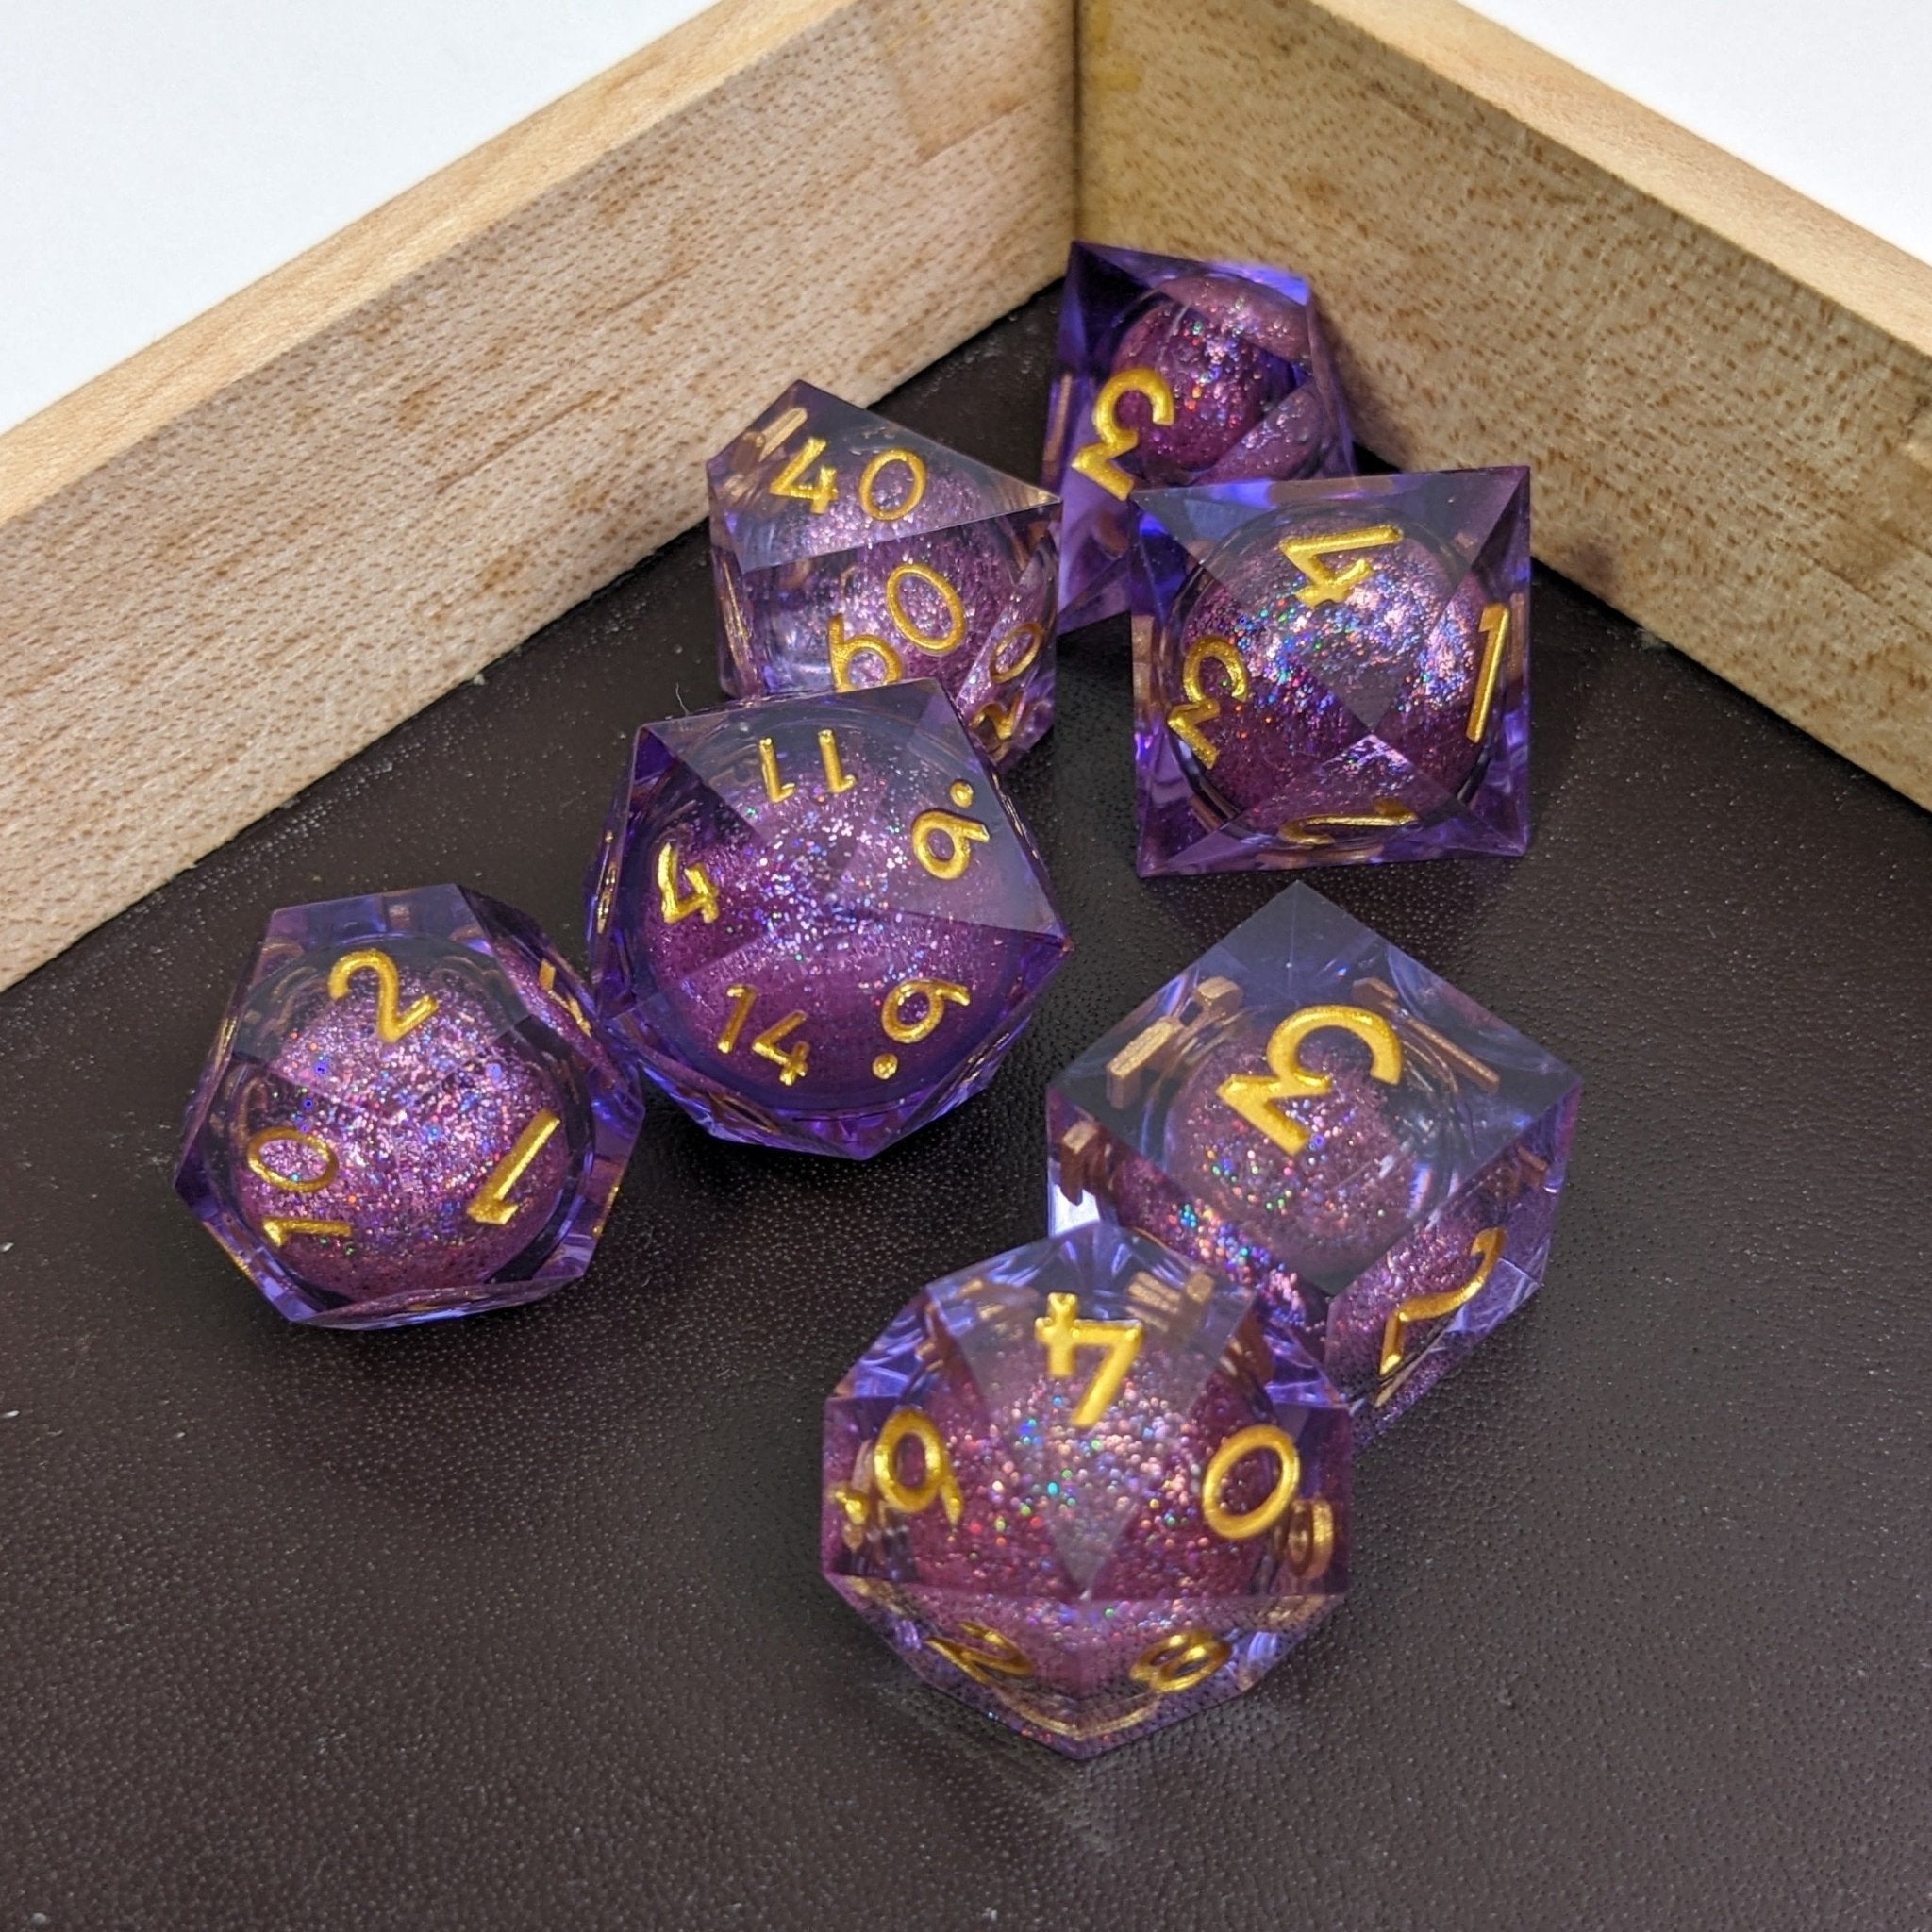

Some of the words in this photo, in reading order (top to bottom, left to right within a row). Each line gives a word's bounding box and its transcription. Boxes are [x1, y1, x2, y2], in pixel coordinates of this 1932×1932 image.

[769, 436, 926, 523] 40
[1072, 369, 1174, 501] 3
[1167, 634, 1247, 770] 3
[1465, 602, 1508, 744] 1
[758, 729, 858, 804] 11
[658, 841, 720, 924] 4
[327, 947, 441, 1045] 2
[717, 984, 810, 1087] 14
[1216, 1004, 1403, 1156] 3
[1034, 1291, 1144, 1428] 4
[1200, 1424, 1301, 1541] 0
